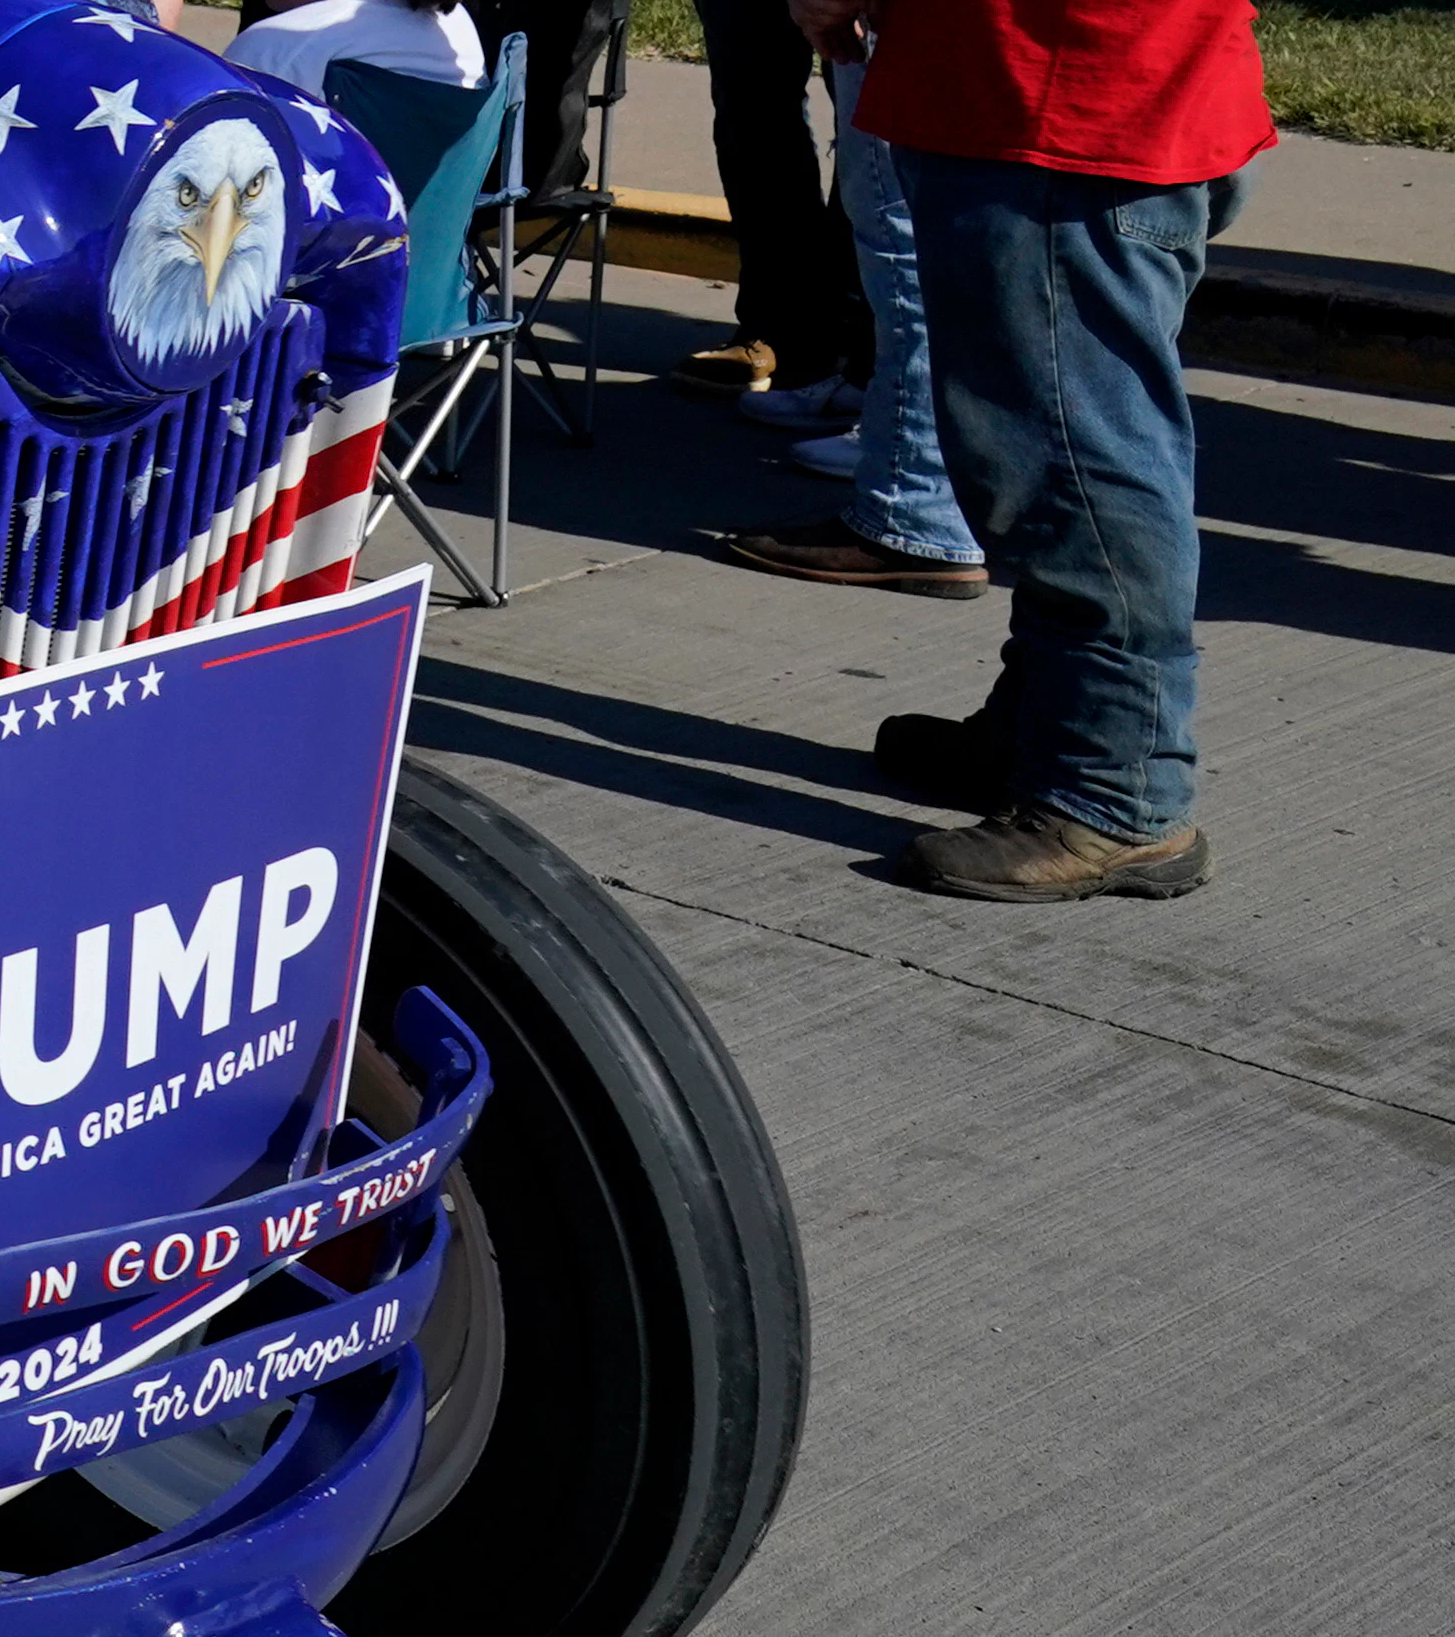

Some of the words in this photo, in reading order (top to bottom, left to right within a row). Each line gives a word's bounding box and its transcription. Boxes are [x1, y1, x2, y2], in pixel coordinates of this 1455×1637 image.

[77, 1074, 185, 1152] GREAT
[194, 1019, 297, 1100] AGAIN!
[23, 1260, 77, 1315] IN
[102, 1225, 241, 1293] GOD
[261, 1200, 324, 1255] WE
[335, 1148, 437, 1227] TRUST
[27, 1411, 125, 1472] Pray
[132, 1371, 190, 1436] For
[193, 1357, 255, 1418] Our
